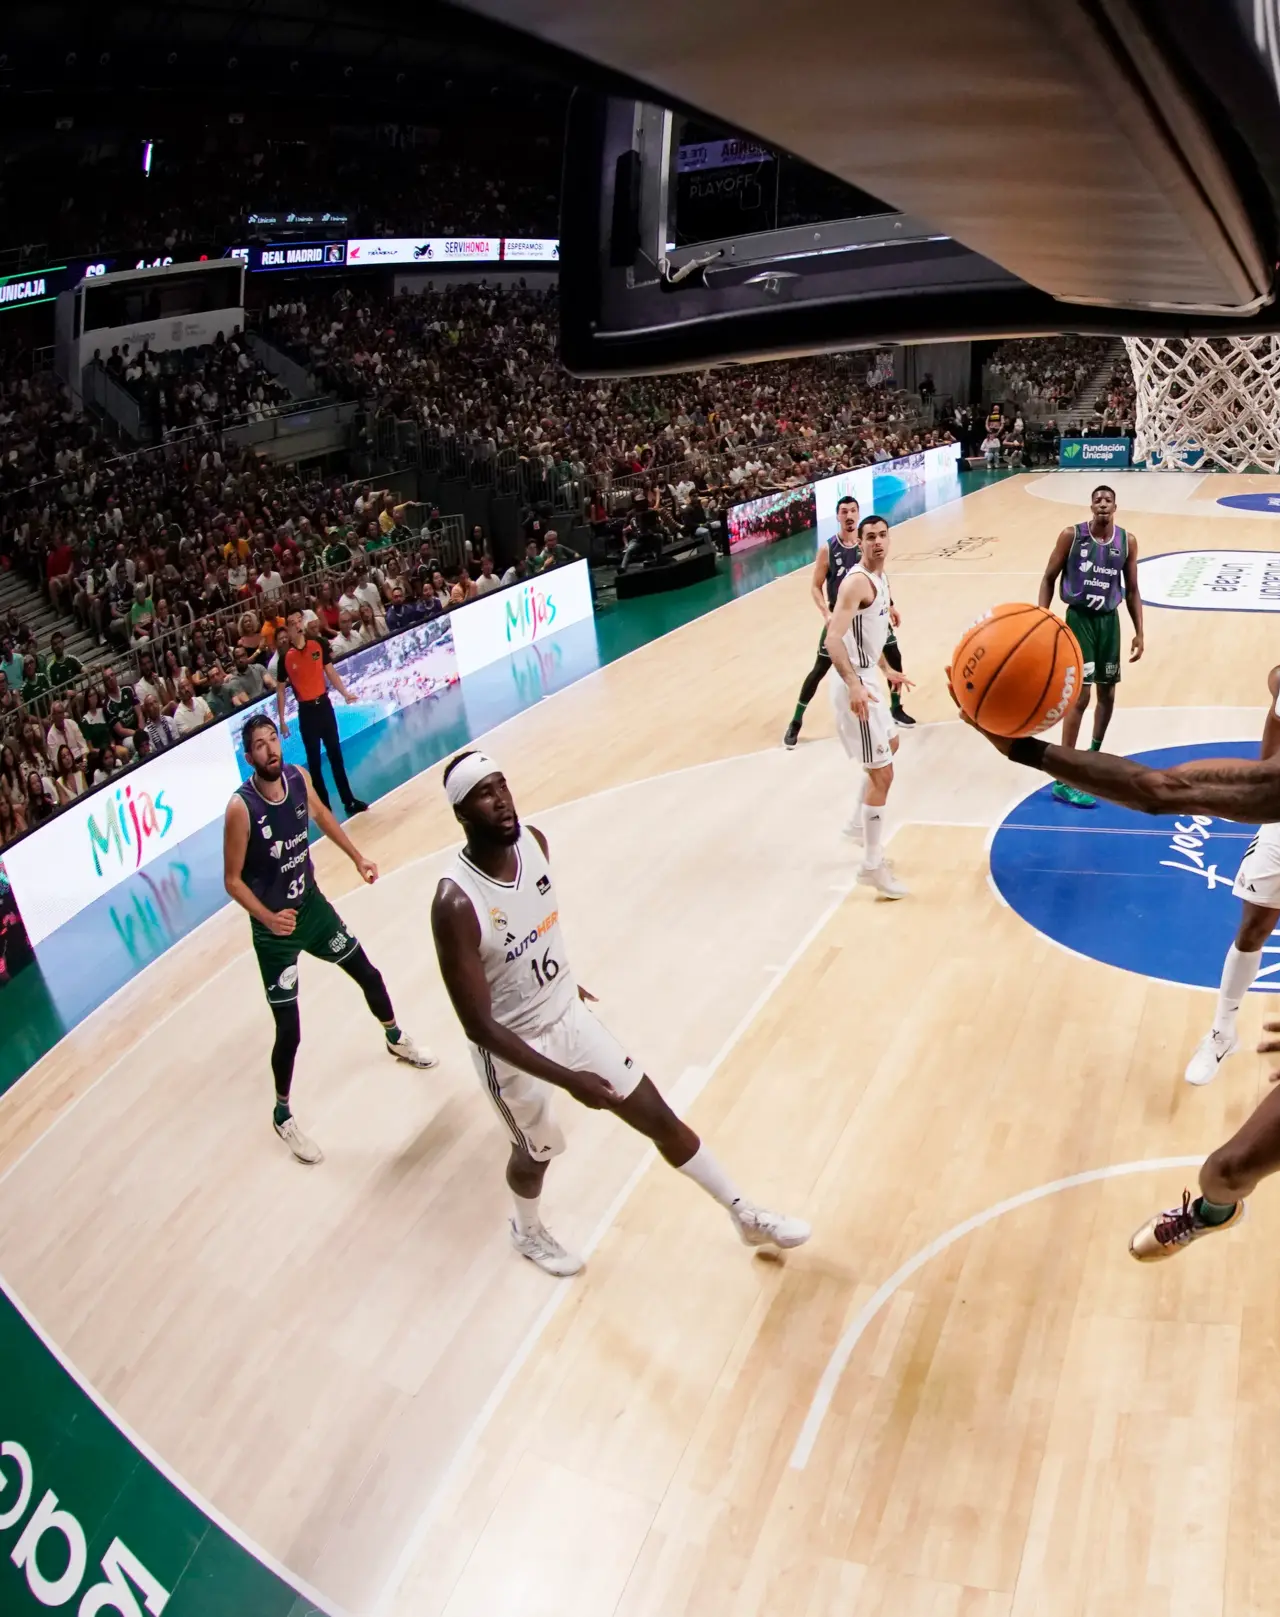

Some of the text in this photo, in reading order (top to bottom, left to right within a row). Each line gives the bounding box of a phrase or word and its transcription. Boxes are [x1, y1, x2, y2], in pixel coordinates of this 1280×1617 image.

[445, 241, 490, 253] SERVIHONDA
[262, 248, 323, 265] REAL MADRID
[1083, 443, 1126, 452] Fundación
[1083, 452, 1113, 461] Unicaja
[1093, 565, 1118, 577] Unicaja
[1203, 562, 1254, 592] Unicaja
[1086, 594, 1105, 611] 77
[505, 586, 557, 642] Mijas
[87, 785, 174, 877] Mijas
[505, 911, 559, 964] AUTOHER
[531, 946, 559, 987] 16
